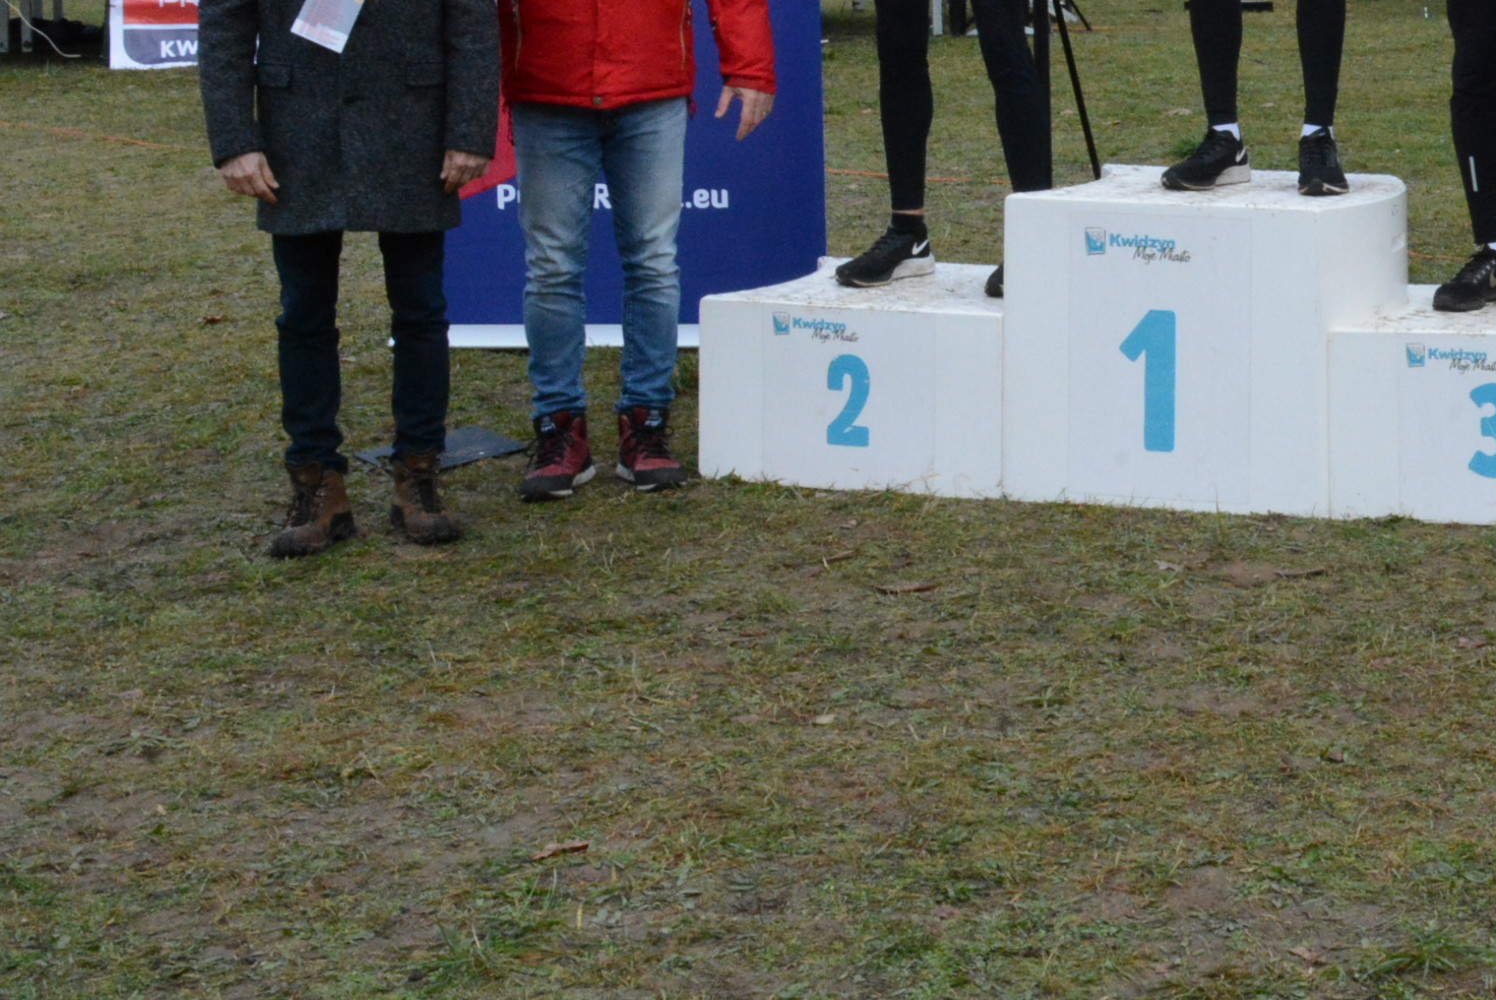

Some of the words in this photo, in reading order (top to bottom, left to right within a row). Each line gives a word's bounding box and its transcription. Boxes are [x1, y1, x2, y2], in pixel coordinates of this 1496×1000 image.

[1109, 232, 1176, 251] Kwidzyn
[1133, 247, 1157, 265] Moje
[792, 317, 846, 332] Kwidzyn
[812, 328, 833, 344] Moje
[1428, 347, 1487, 362] Kwidzyn
[1449, 357, 1471, 373] Moje
[1119, 309, 1176, 452] 1
[826, 353, 870, 447] 2
